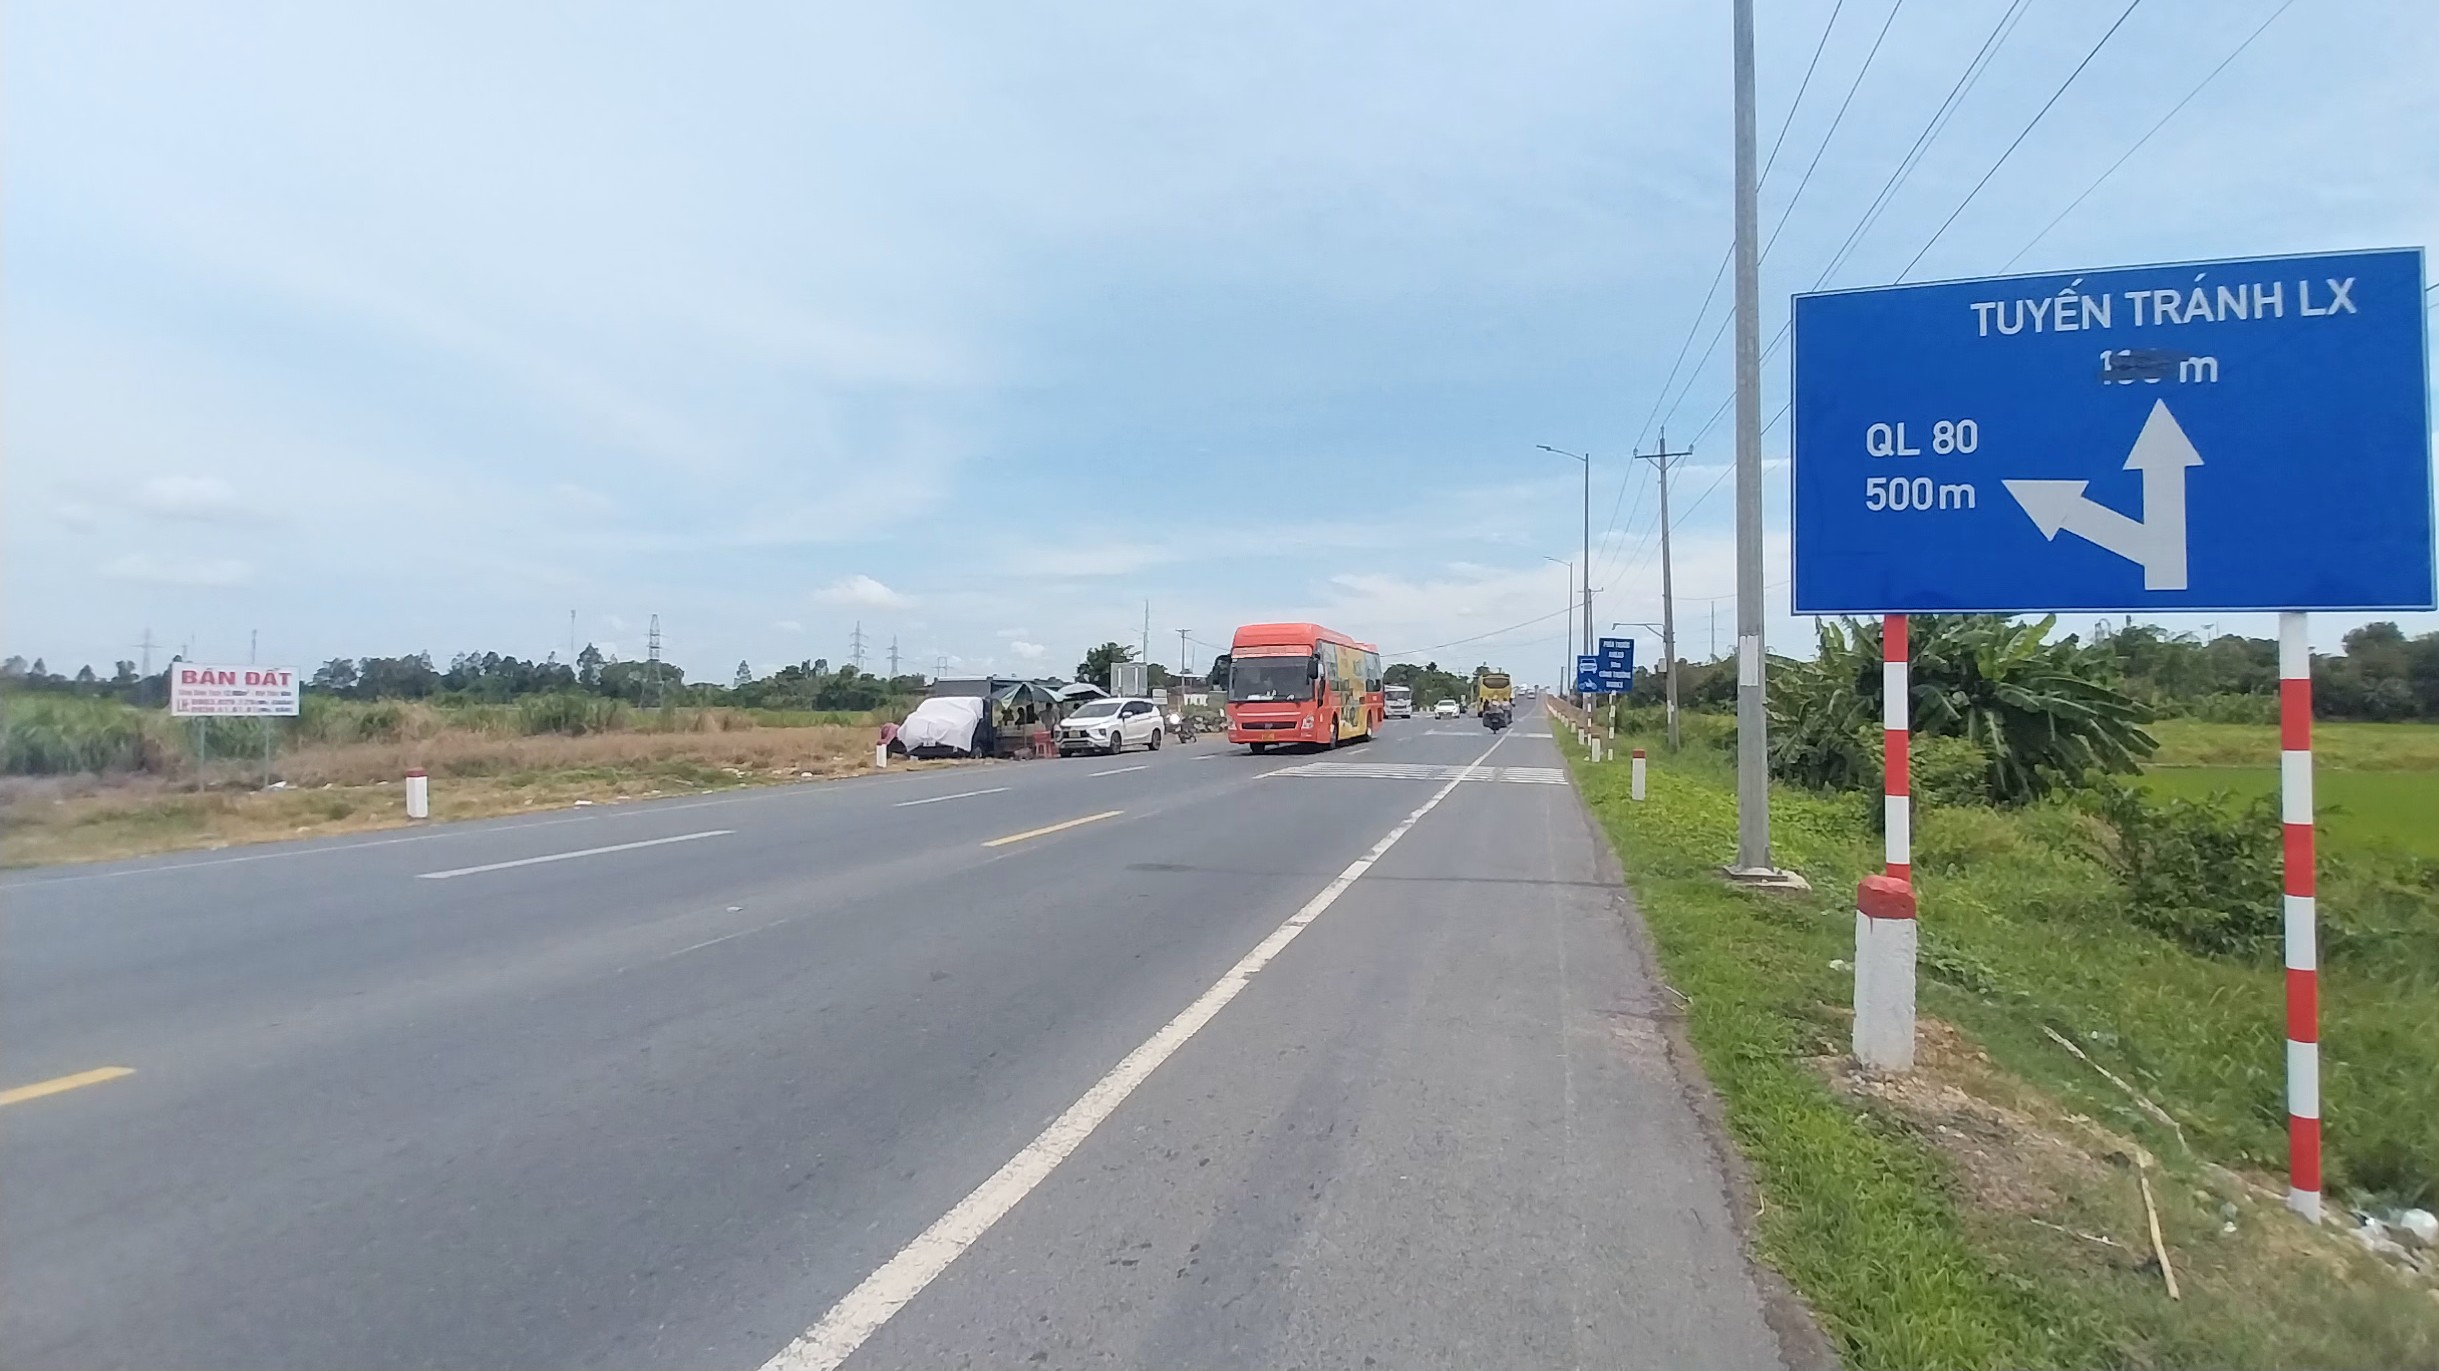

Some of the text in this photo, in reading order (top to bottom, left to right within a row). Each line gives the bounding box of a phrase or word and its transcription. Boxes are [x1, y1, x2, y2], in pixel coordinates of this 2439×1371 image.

[1970, 273, 2356, 337] TUYẾN TRÁNH LX
[1866, 419, 1978, 457] QL 80
[1866, 477, 1976, 511] 500m
[181, 667, 236, 685] BÁN
